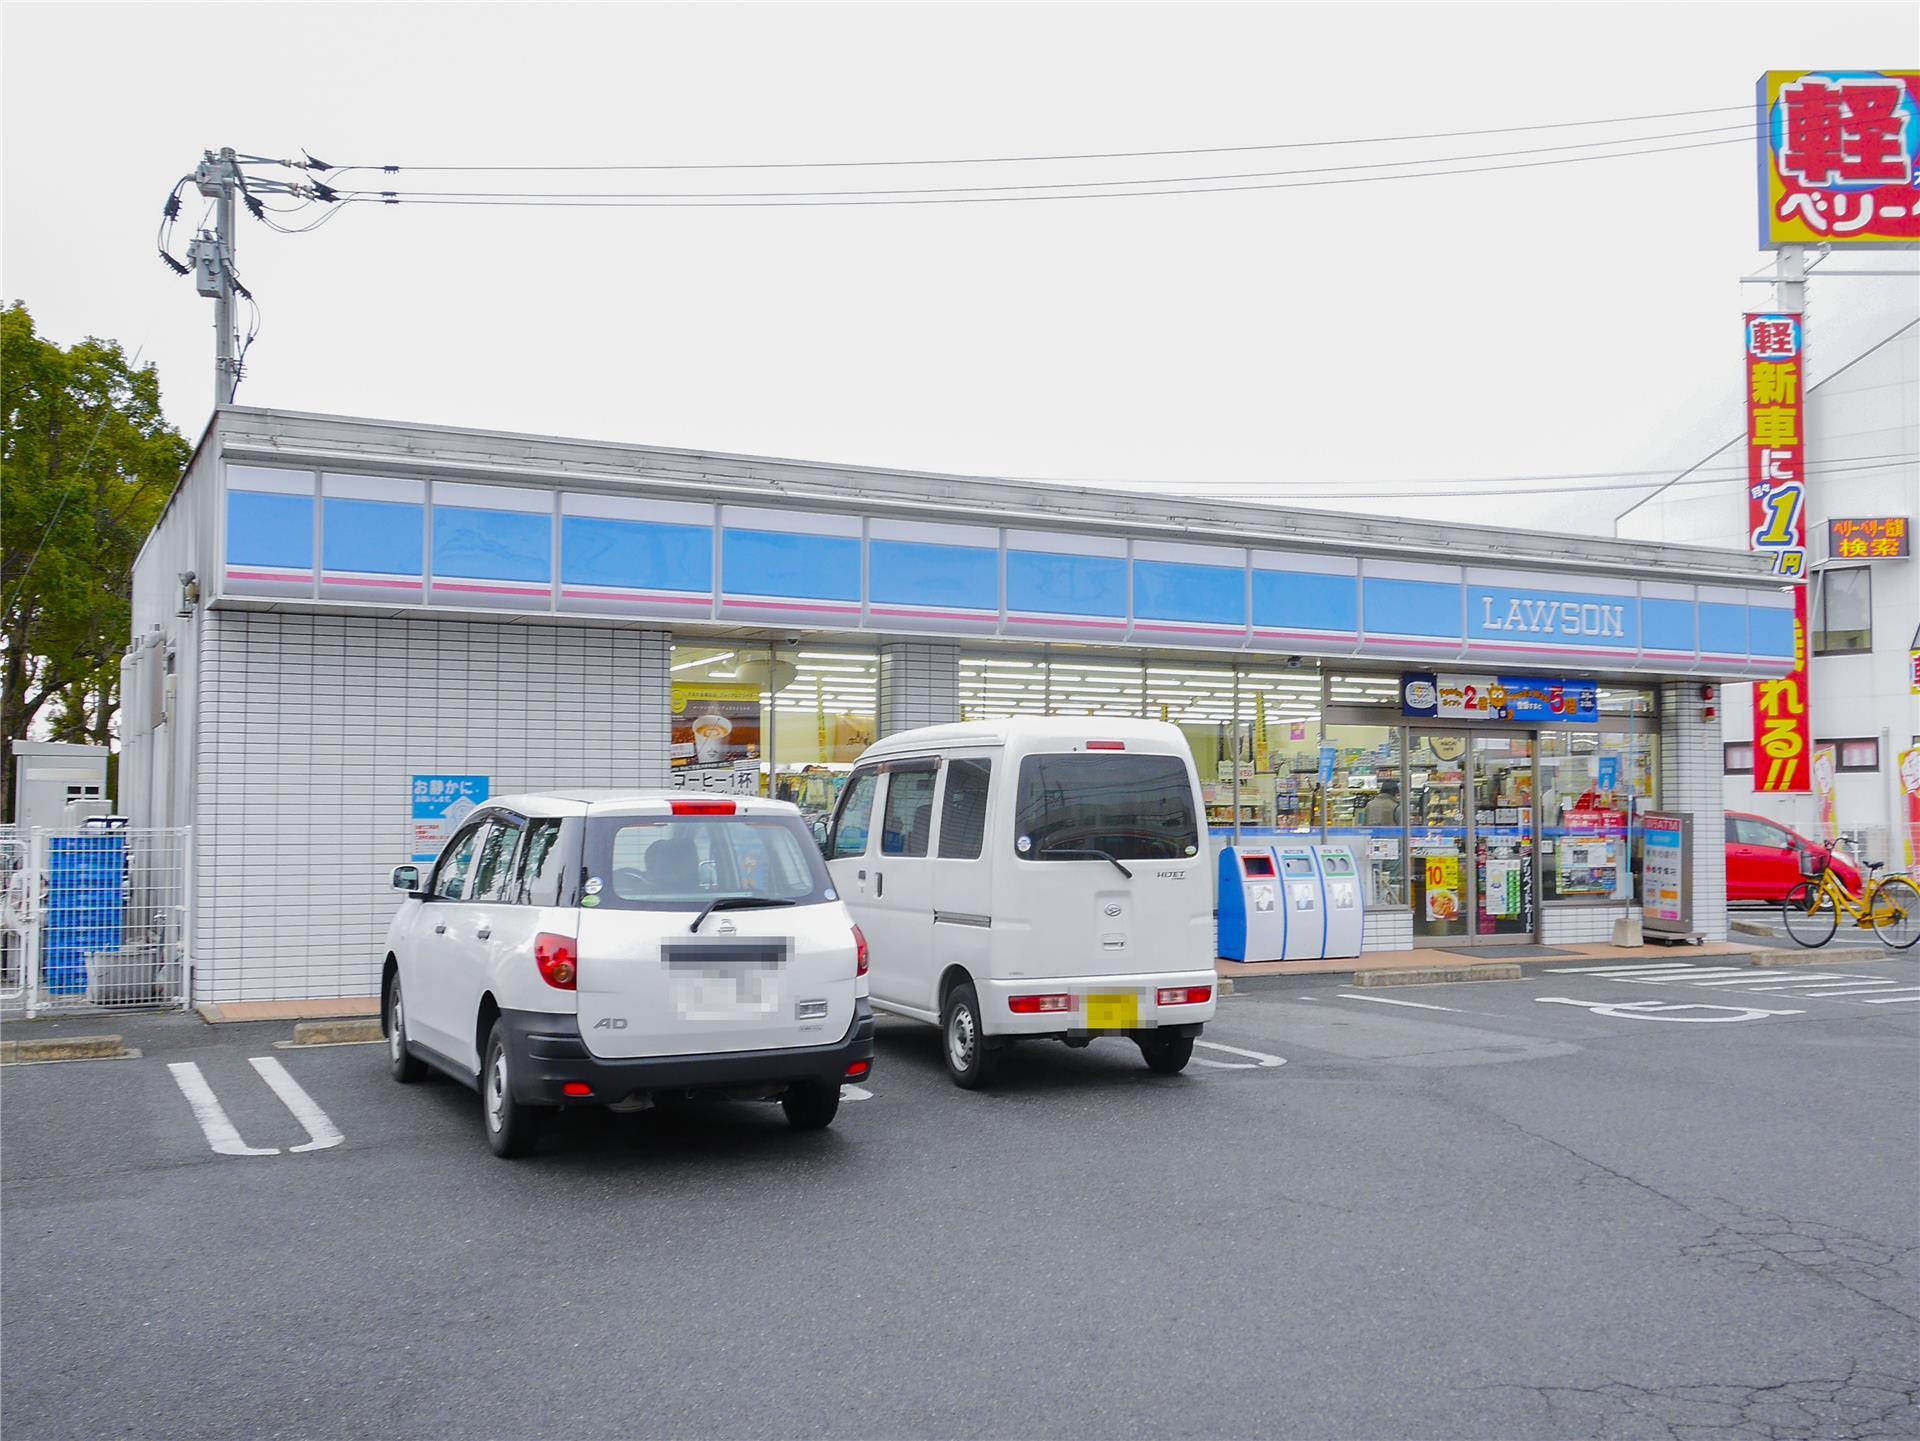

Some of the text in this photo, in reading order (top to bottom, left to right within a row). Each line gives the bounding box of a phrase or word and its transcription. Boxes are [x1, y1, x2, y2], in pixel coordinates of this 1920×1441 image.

[1782, 79, 1908, 184] 軽
[1780, 192, 1920, 231] ベリー
[1751, 319, 1797, 355] 軽
[1751, 362, 1798, 480] 新車に
[1839, 537, 1900, 557] 検索
[1481, 596, 1625, 638] LAWSON
[414, 779, 473, 795] お静かに
[673, 772, 753, 788] コーヒー1杯
[1427, 865, 1442, 886] 10
[592, 1017, 628, 1030] AD
